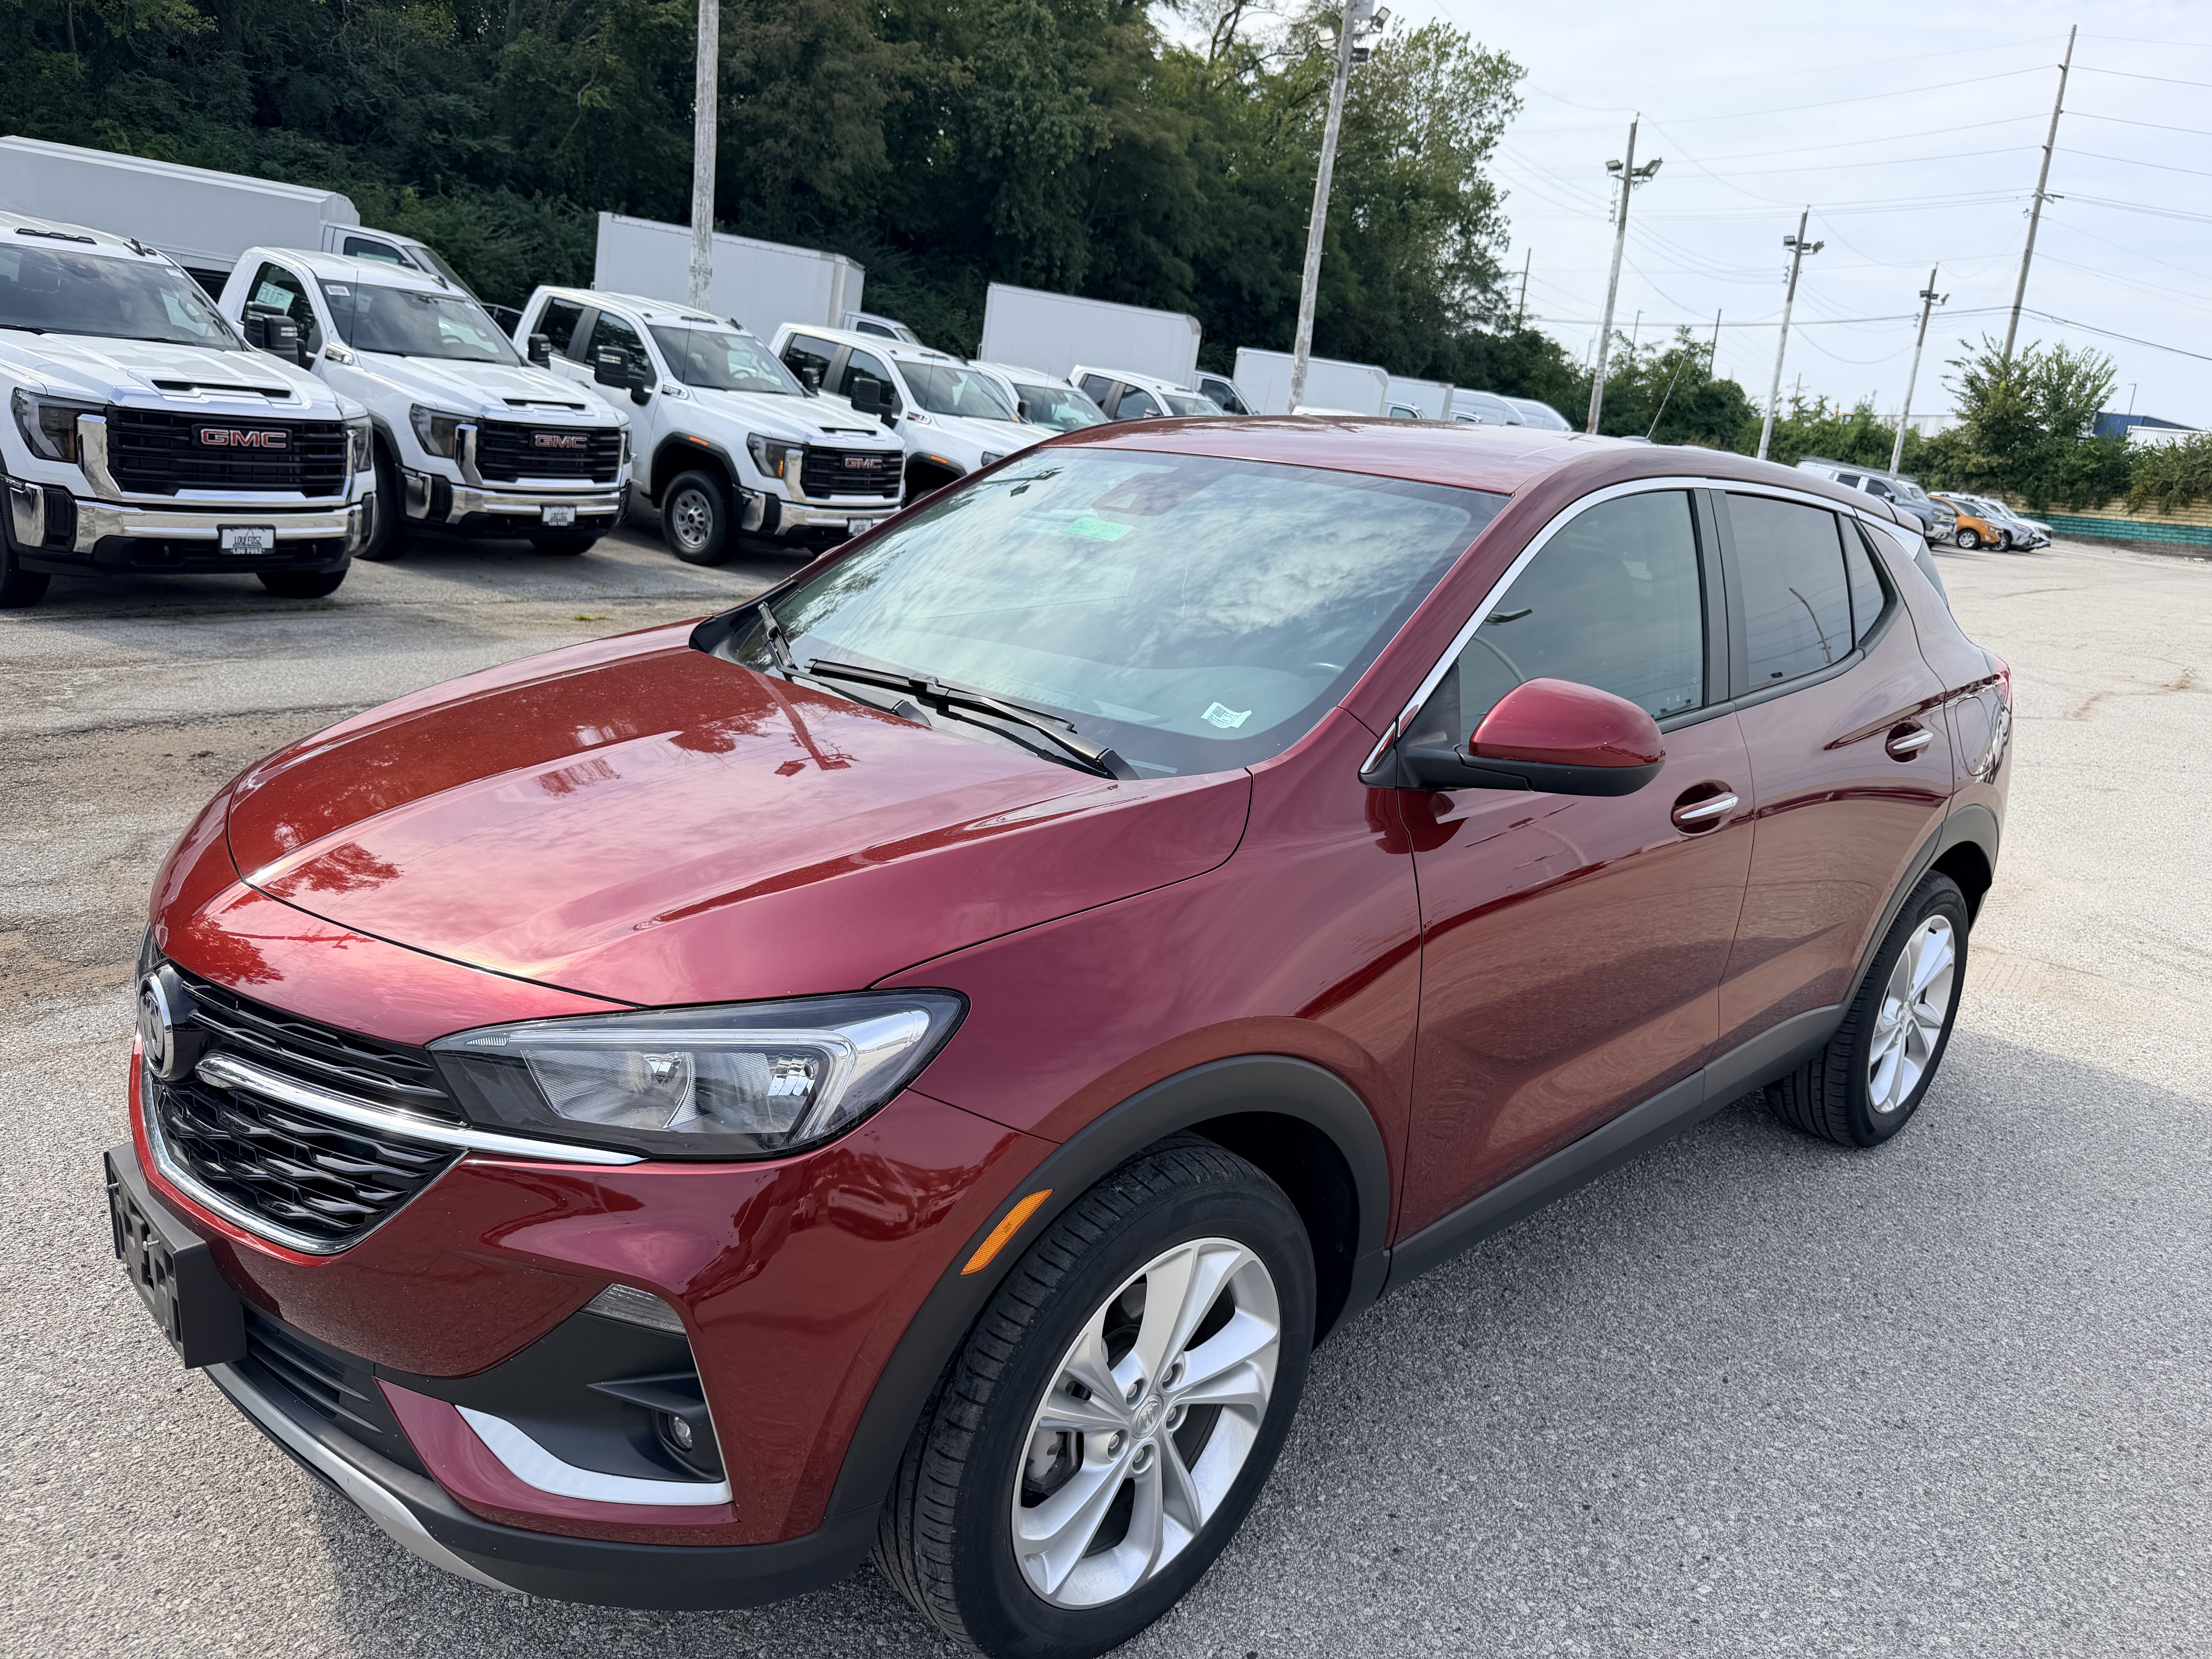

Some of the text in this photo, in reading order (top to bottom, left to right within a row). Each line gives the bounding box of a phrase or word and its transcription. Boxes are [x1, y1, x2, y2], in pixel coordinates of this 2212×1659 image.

[201, 429, 286, 448] GMC
[535, 434, 587, 448] GMC
[845, 457, 882, 469] GMC
[235, 536, 261, 544] LOU FUSZ
